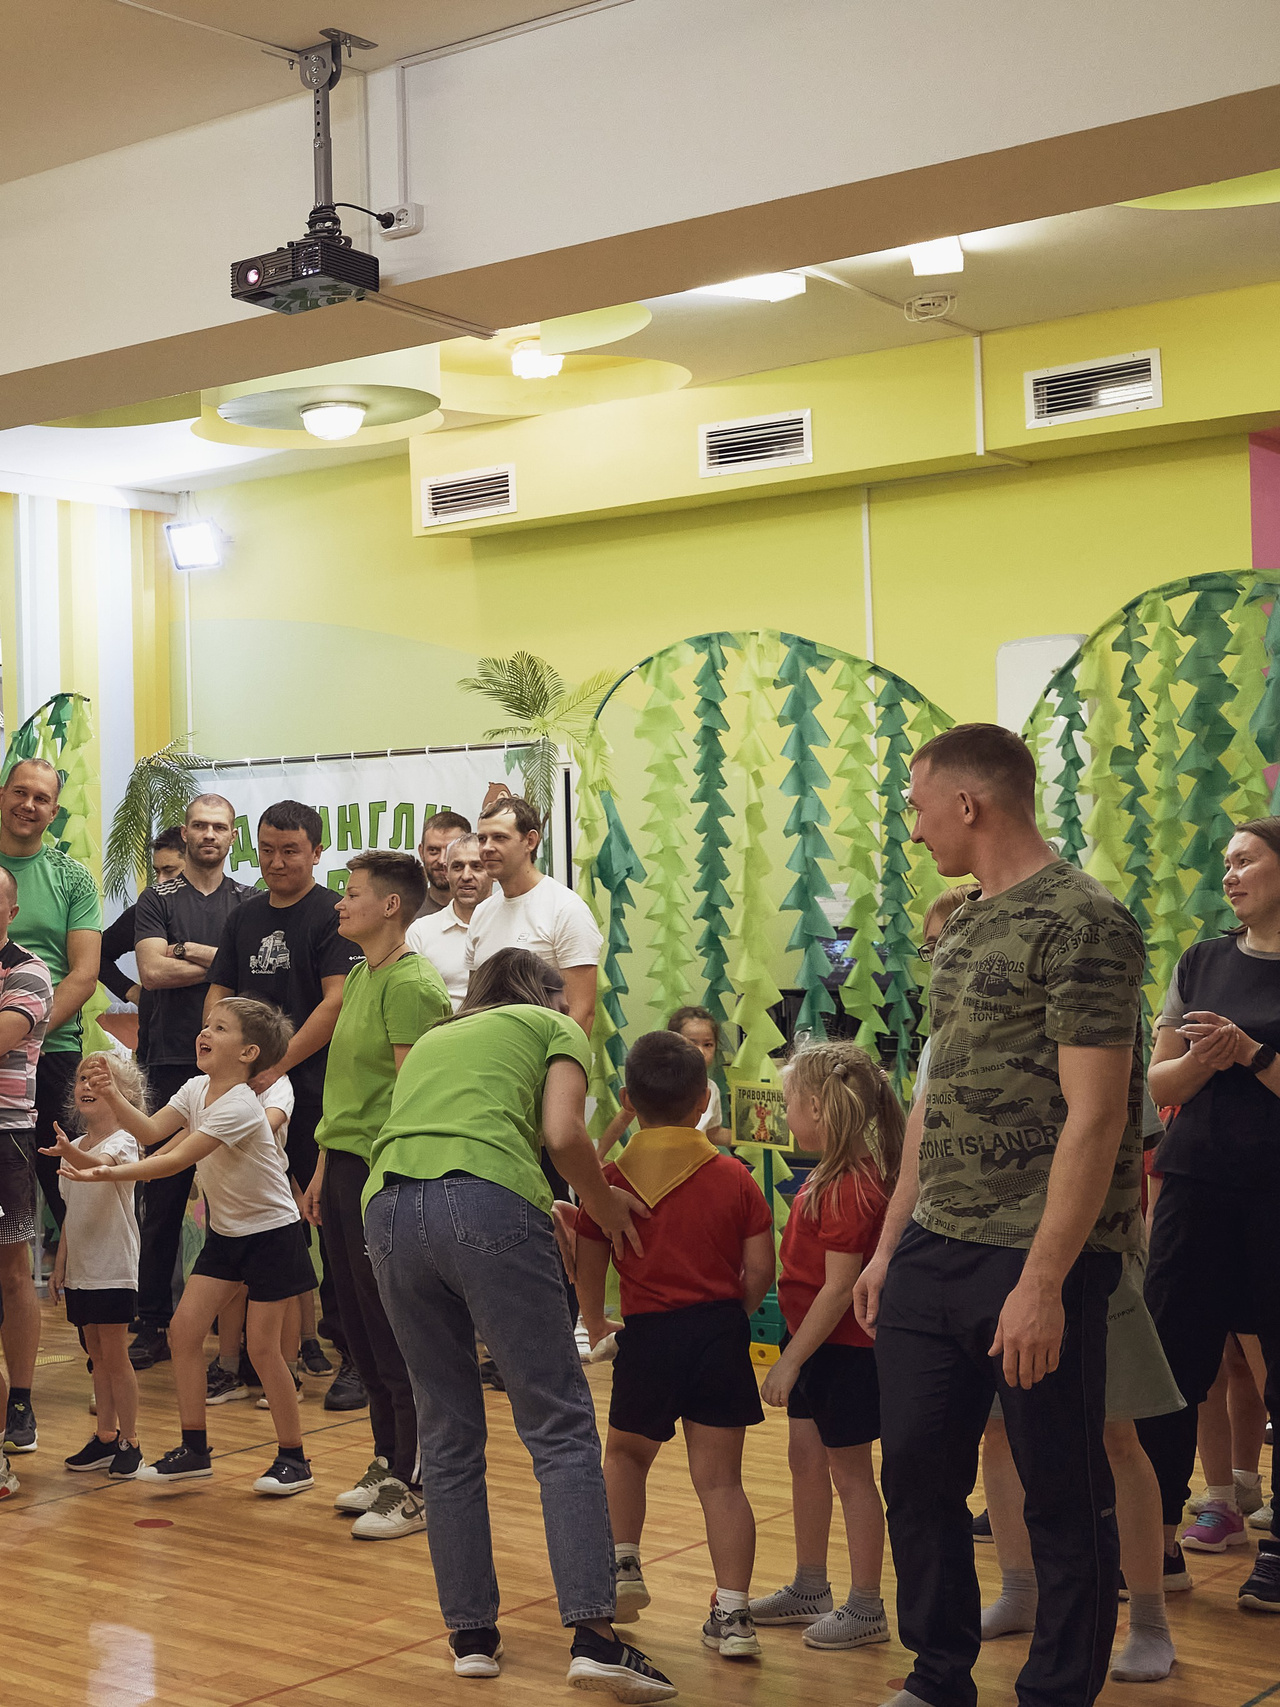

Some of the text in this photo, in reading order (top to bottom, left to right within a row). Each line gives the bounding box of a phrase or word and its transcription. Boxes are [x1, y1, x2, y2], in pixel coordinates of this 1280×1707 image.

[230, 801, 452, 872] ДНГЛ
[969, 1011, 1000, 1023] STONE
[981, 1062, 1006, 1075] STONE
[737, 1088, 785, 1104] ТРАВОЯДНЫ
[931, 1093, 952, 1105] STONE
[919, 1138, 954, 1161] STONE
[934, 1217, 957, 1232] STONE
